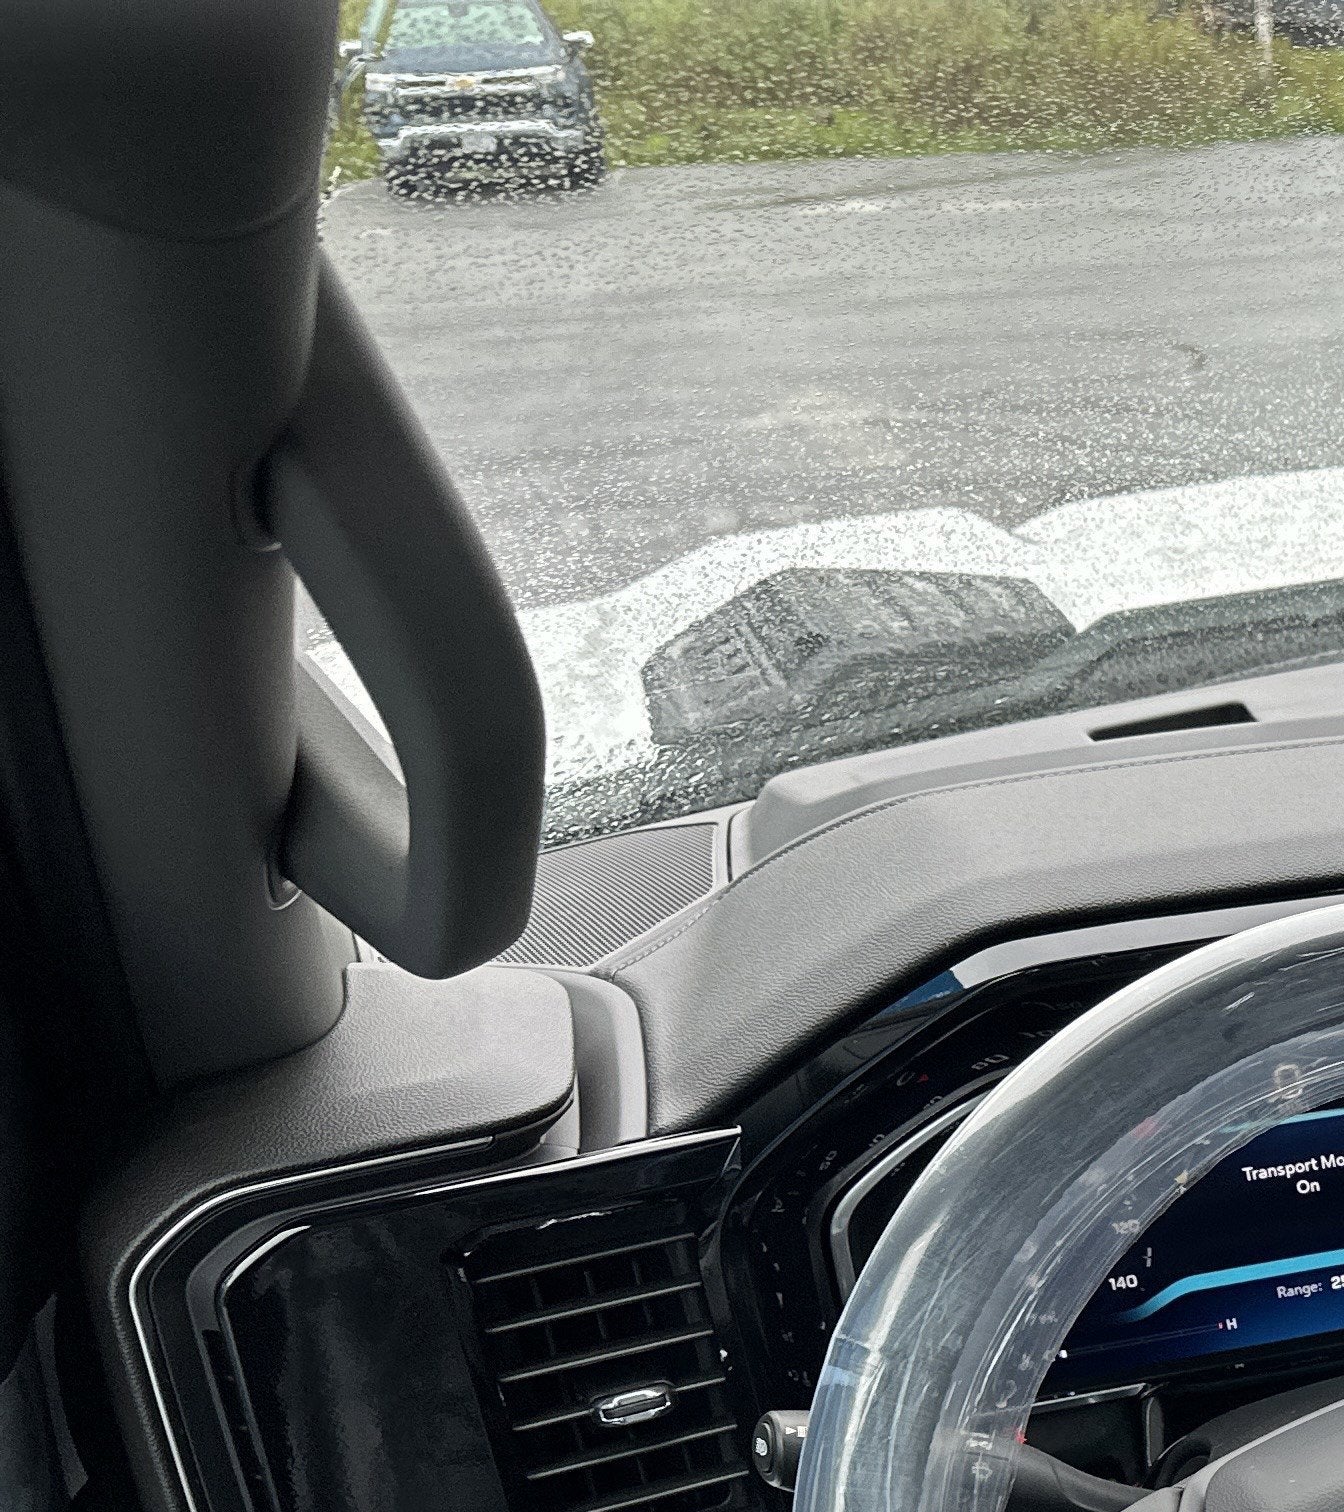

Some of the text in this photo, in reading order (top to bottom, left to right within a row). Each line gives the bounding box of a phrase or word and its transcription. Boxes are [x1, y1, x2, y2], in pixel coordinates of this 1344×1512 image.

[1241, 1157, 1319, 1181] Transport
[1296, 1180, 1321, 1194] On
[1108, 1274, 1138, 1291] 140
[1276, 1282, 1323, 1298] Range:
[1226, 1317, 1238, 1331] H
